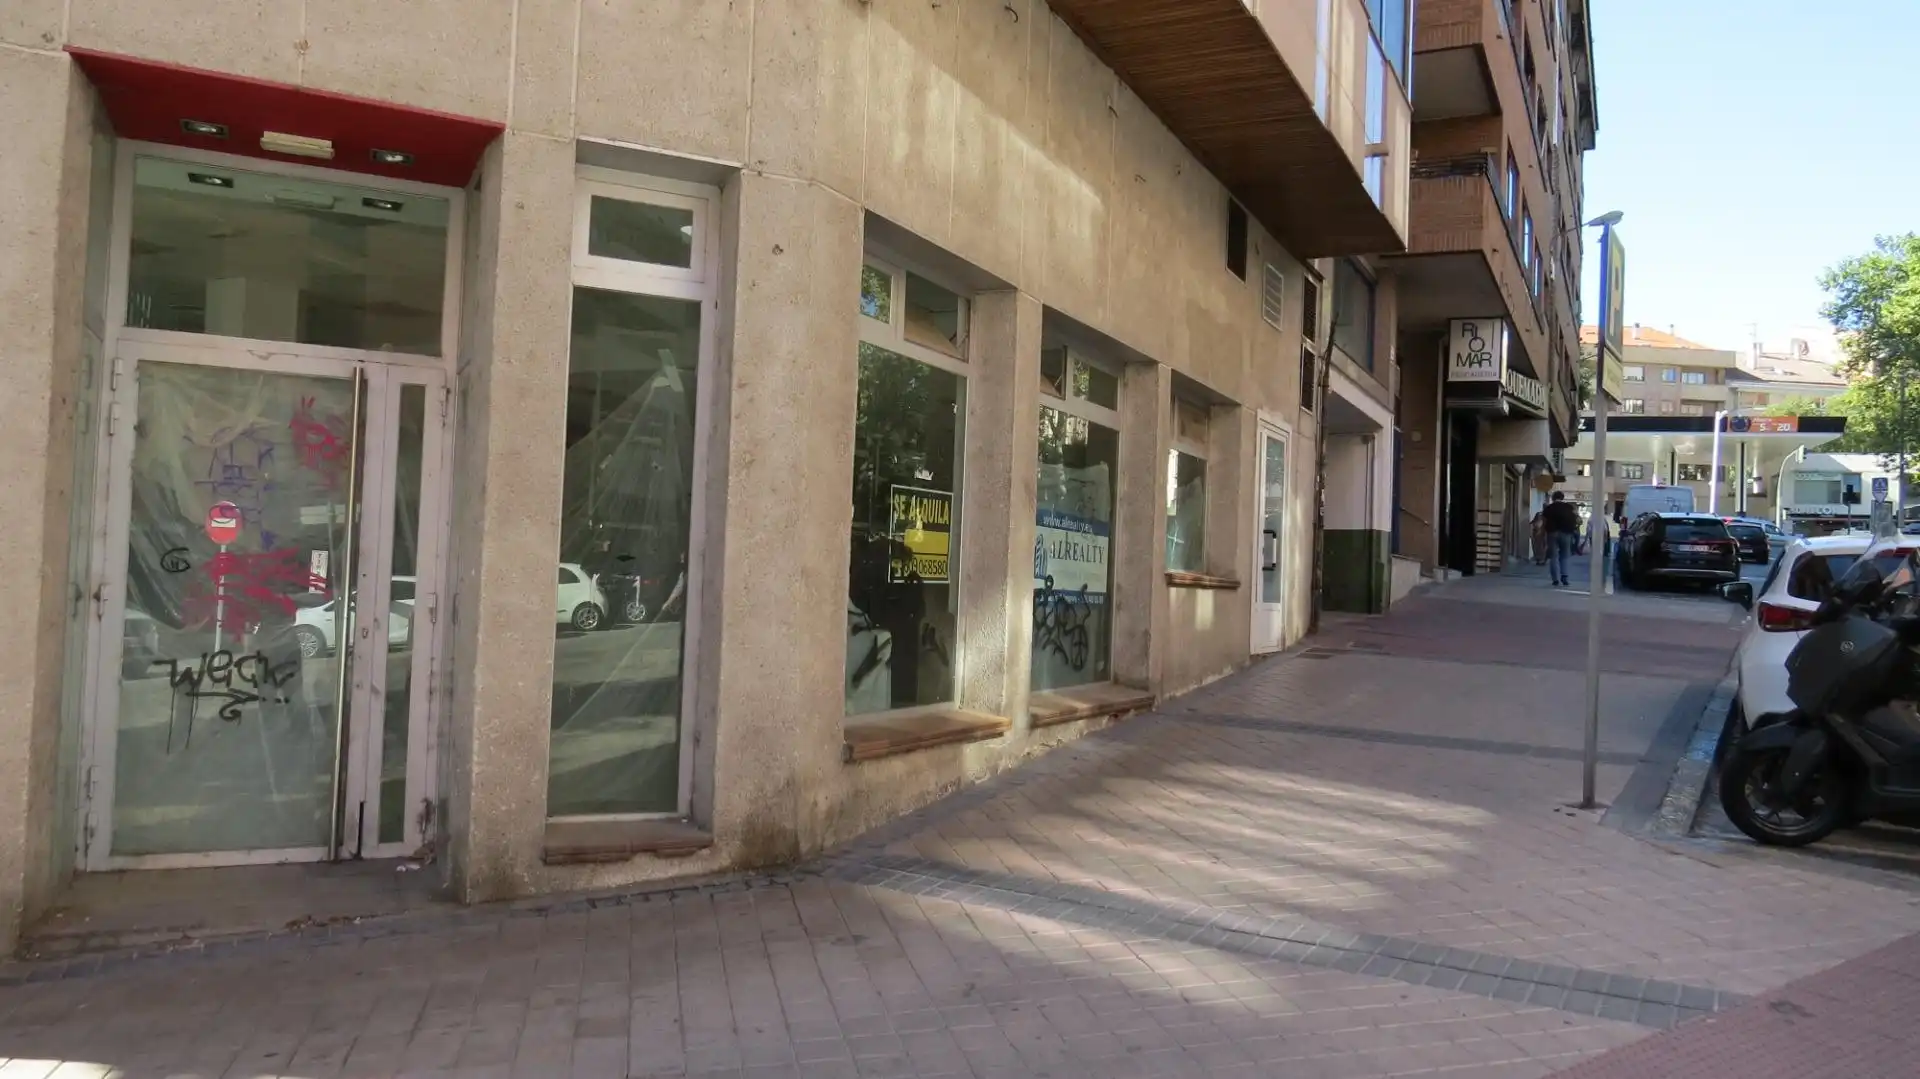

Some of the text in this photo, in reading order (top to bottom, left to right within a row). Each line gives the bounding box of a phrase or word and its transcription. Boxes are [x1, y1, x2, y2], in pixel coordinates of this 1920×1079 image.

[1456, 351, 1493, 368] MAR
[894, 493, 950, 524] SE ALQUILA
[1049, 540, 1105, 564] ALREALTY
